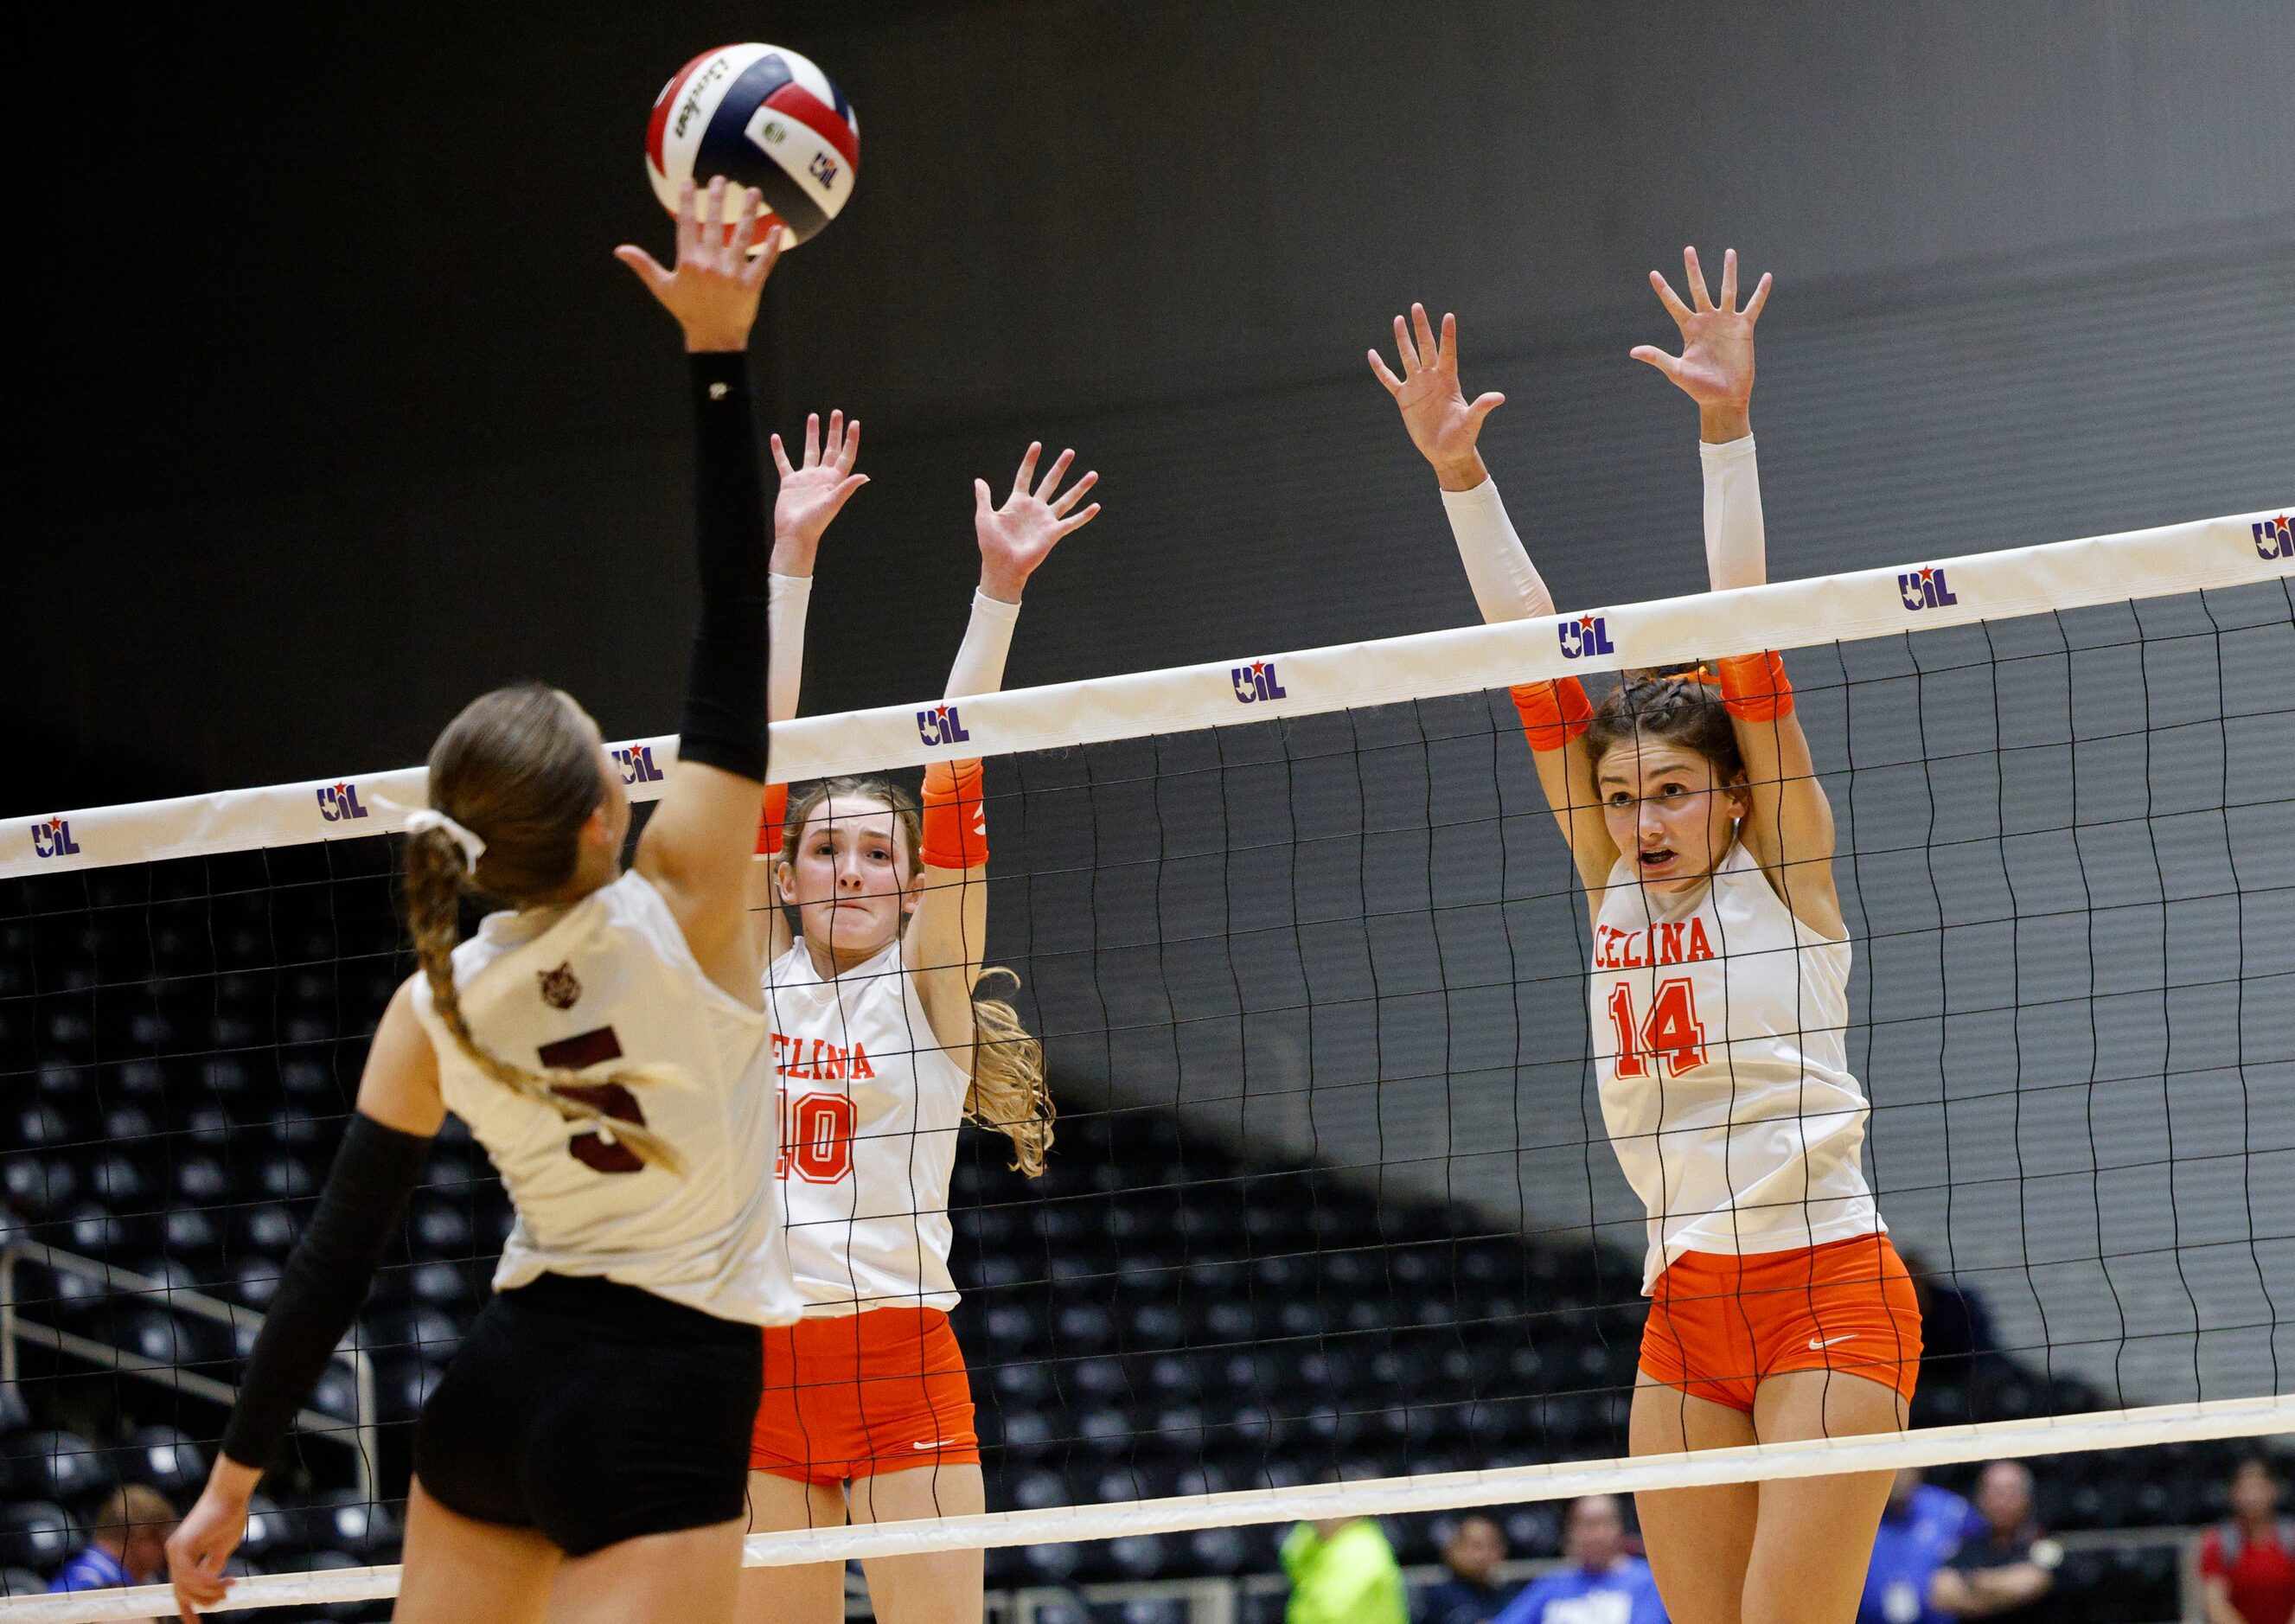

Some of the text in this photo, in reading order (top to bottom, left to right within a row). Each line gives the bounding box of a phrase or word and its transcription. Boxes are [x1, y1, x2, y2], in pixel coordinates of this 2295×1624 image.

[2252, 515, 2295, 559] UI
[1899, 566, 1956, 611] UIL
[1559, 615, 1614, 659] UIL
[1231, 662, 1286, 703] UIL
[917, 705, 969, 746] UIL
[316, 782, 367, 820] UIL
[31, 817, 80, 858] UIL
[1595, 917, 1715, 969] CELINA
[1608, 976, 1709, 1081] 14
[770, 1033, 875, 1080] ELINA
